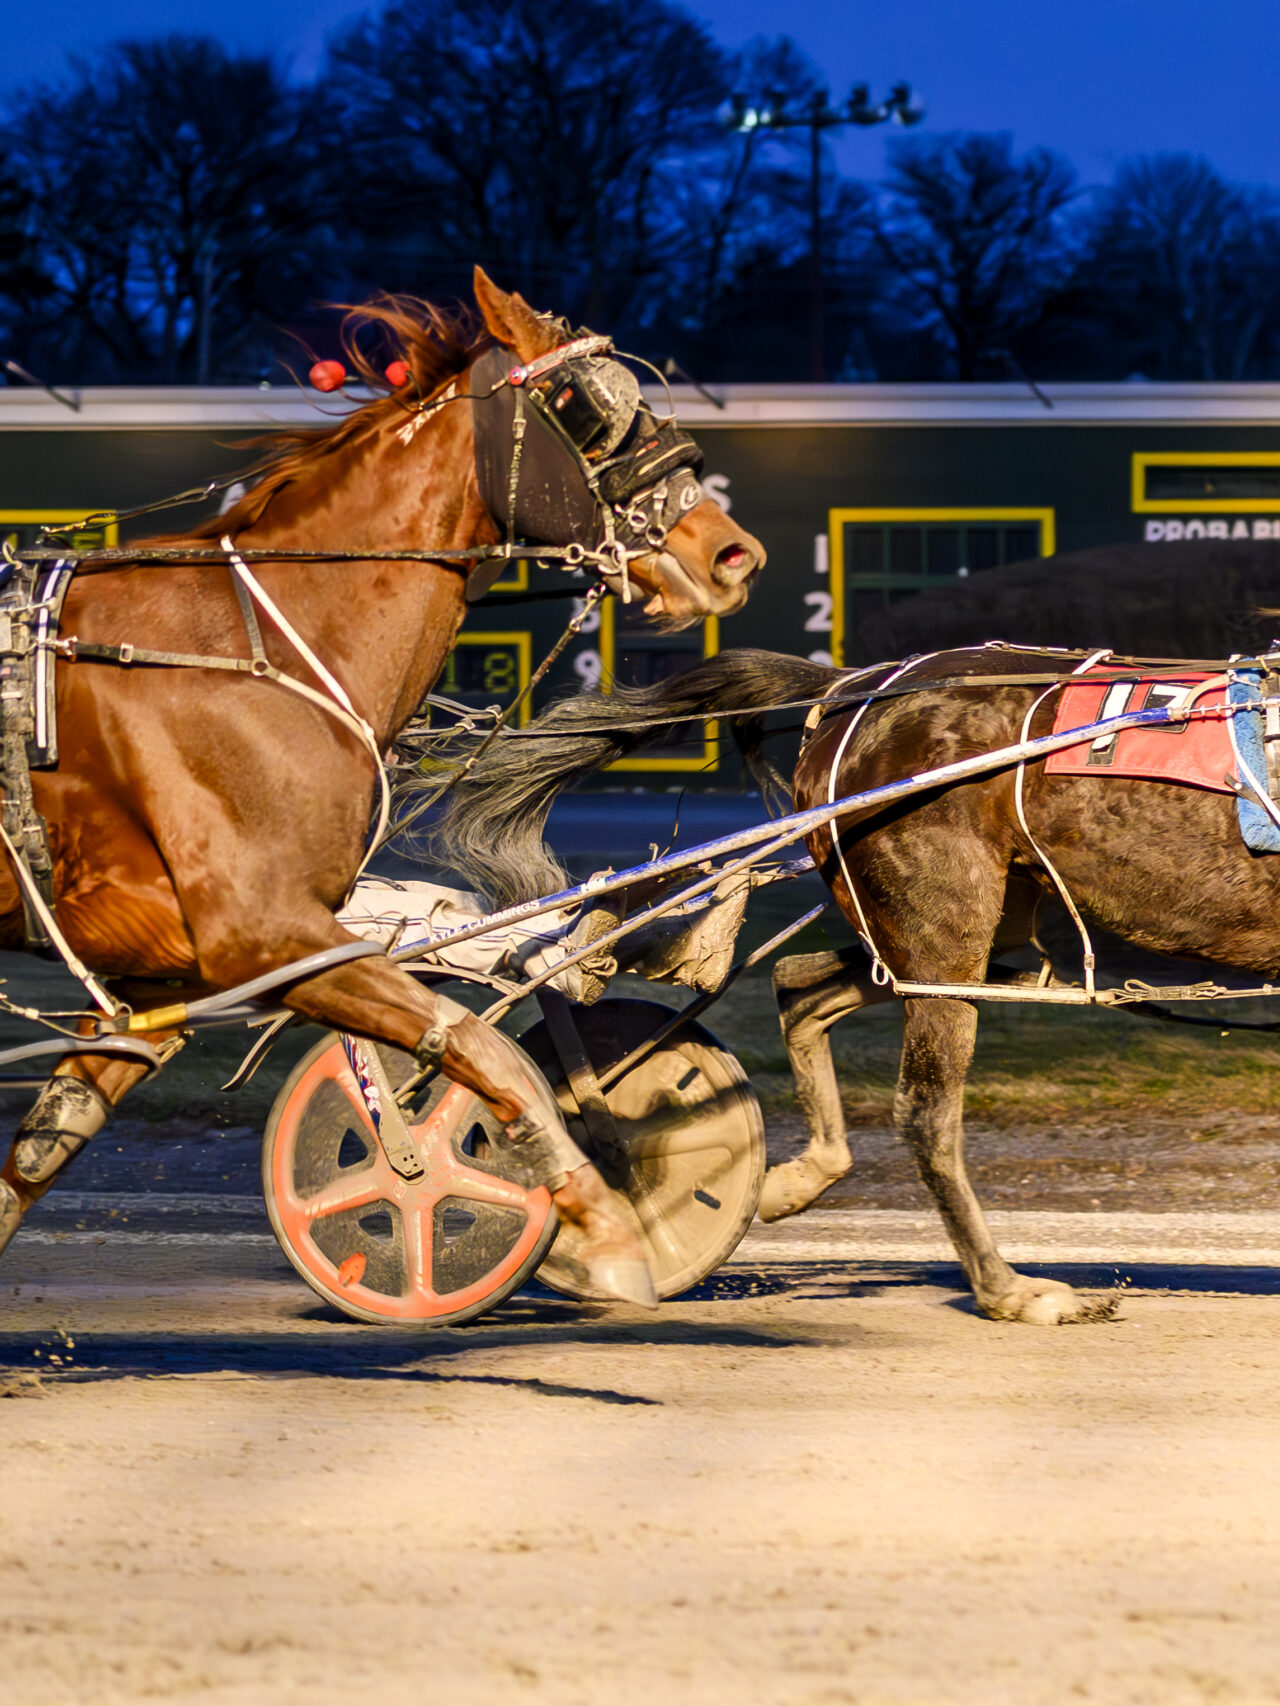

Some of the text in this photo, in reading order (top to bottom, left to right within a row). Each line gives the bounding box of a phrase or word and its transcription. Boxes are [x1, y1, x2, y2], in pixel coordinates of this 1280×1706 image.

[803, 590, 834, 632] 2
[574, 650, 602, 691] 9
[467, 899, 540, 931] CUMMINGS
